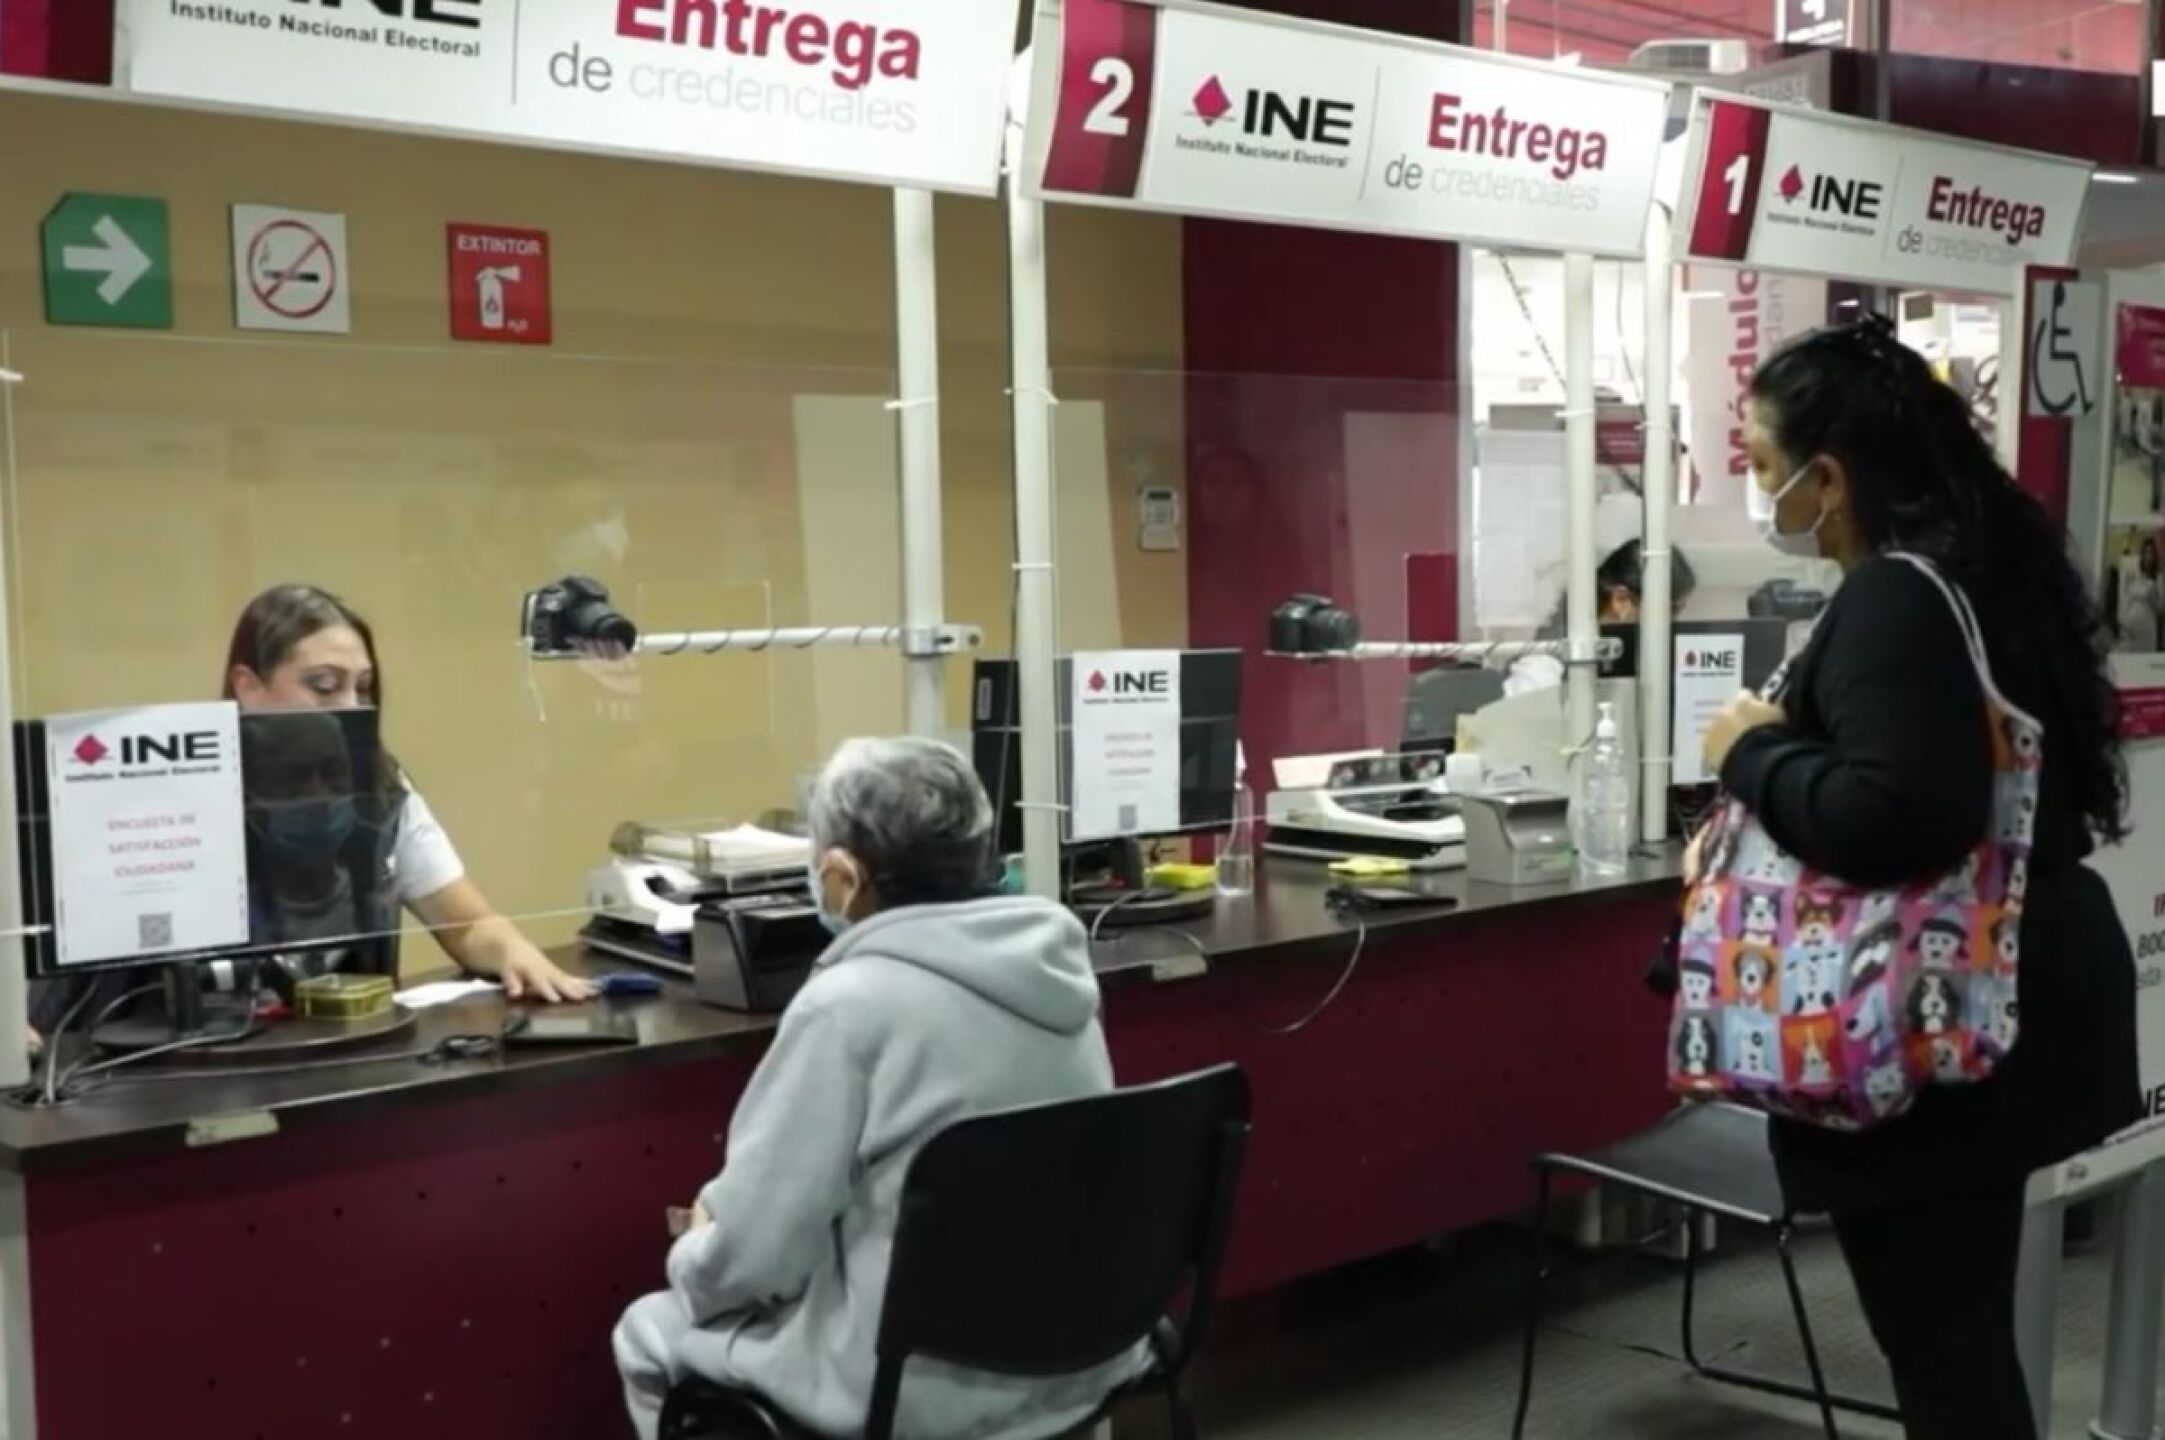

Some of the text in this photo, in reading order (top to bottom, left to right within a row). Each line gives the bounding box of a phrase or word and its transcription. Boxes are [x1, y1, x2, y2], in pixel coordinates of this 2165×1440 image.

[171, 0, 271, 28] Instituto
[279, 14, 378, 43] Nacional
[386, 29, 480, 57] Electoral
[616, 0, 921, 90] Entrega
[549, 42, 917, 133] de credenciales
[1083, 58, 1134, 136] 2
[1243, 89, 1353, 147] INE
[1427, 92, 1607, 181] Entrega
[1385, 153, 1600, 212] de credenciales
[1724, 155, 1749, 214] 1
[1810, 173, 1882, 219] INE
[1927, 174, 2045, 246] Entrega
[458, 235, 541, 256] EXTINTOR
[1898, 224, 1922, 253] de
[1113, 670, 1168, 693] INE
[1701, 651, 1736, 669] INE
[120, 731, 219, 765] INE
